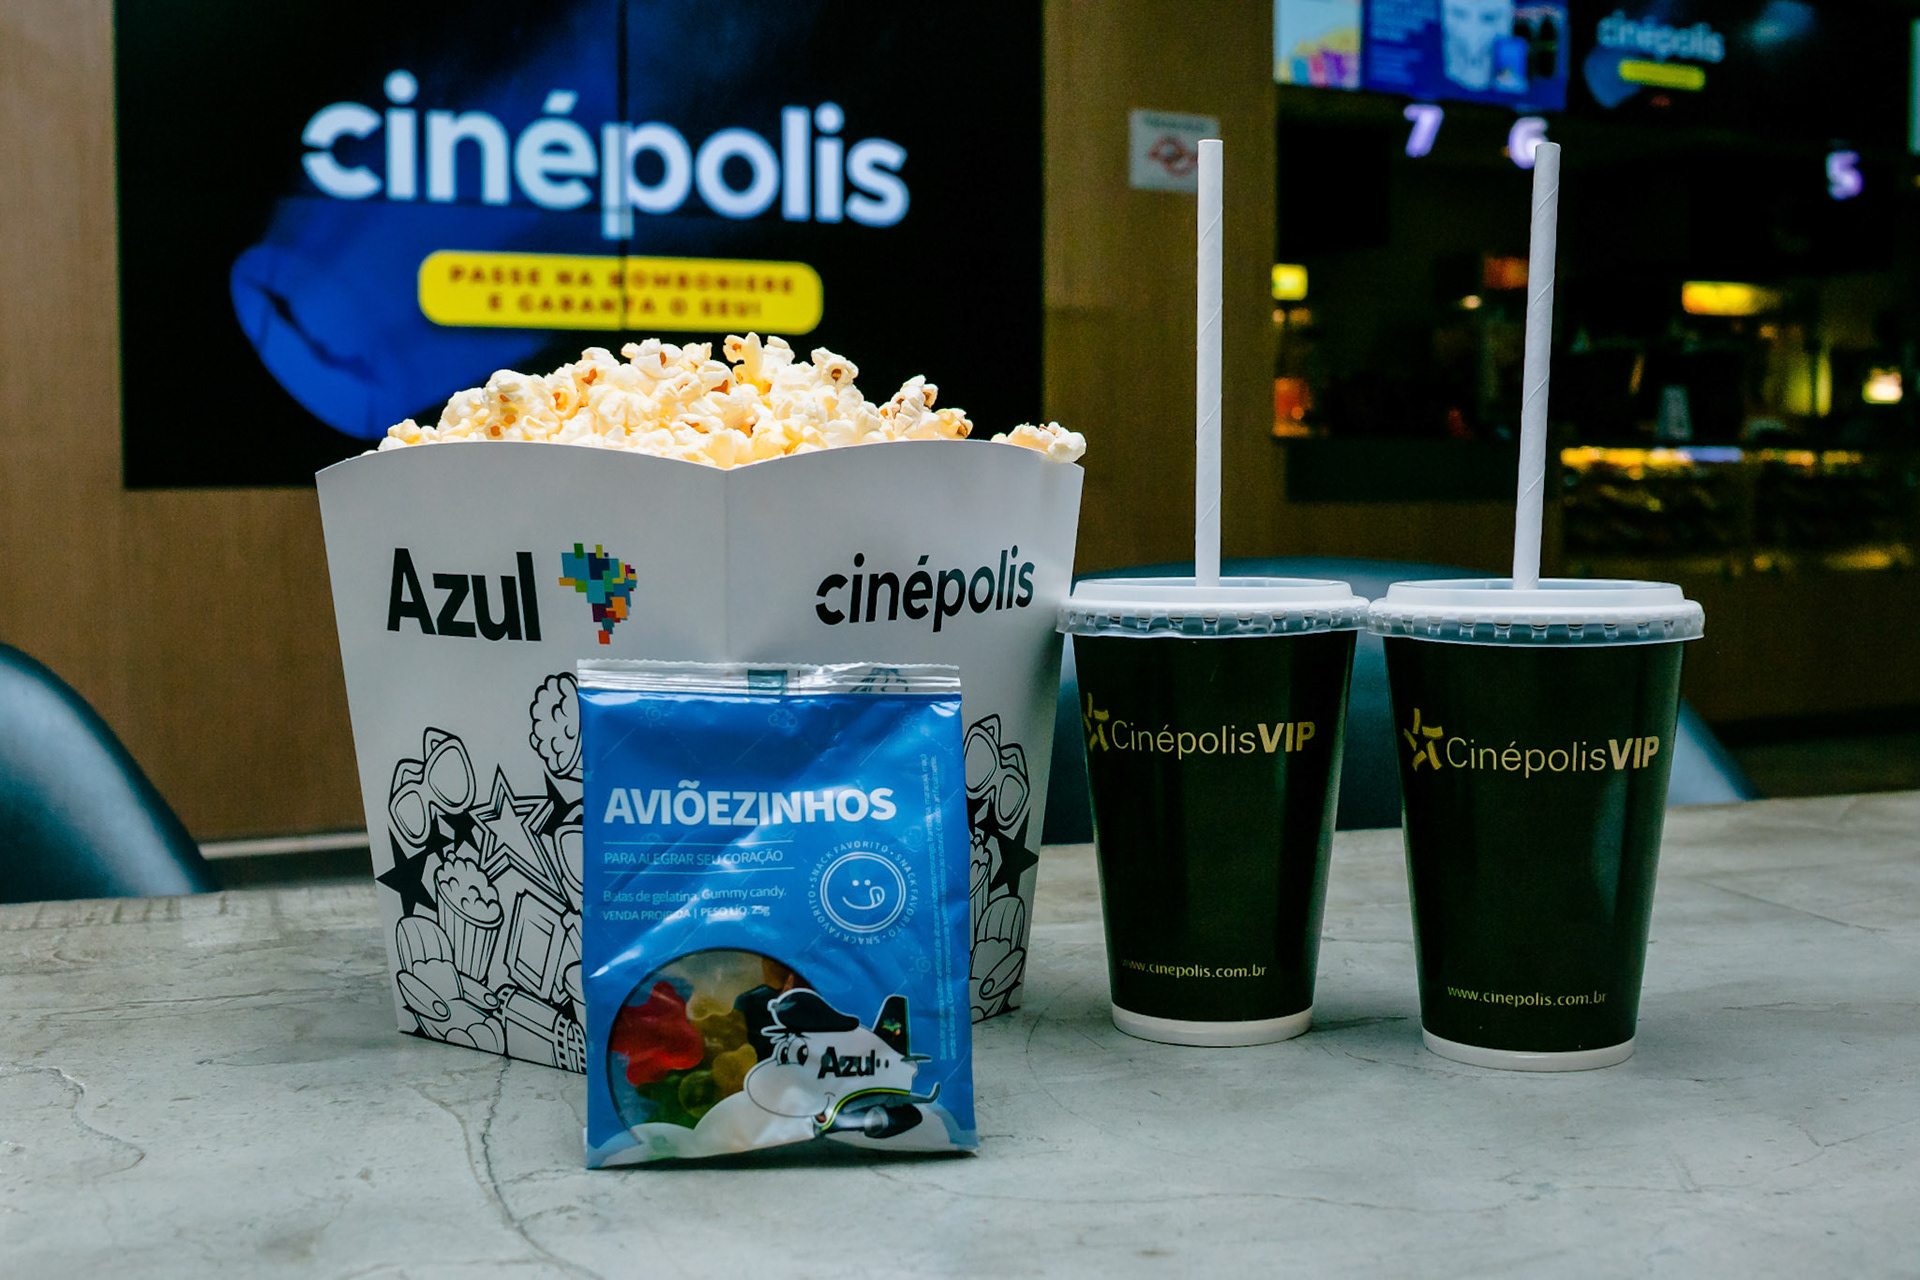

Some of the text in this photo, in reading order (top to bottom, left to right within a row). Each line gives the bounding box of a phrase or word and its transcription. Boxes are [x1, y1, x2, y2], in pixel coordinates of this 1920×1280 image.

[302, 69, 911, 240] cinépolis
[1403, 104, 1445, 157] 7
[1508, 116, 1550, 169] 6
[1825, 150, 1864, 201] 5
[387, 547, 542, 641] Azul
[815, 544, 1036, 633] cinépolis
[603, 779, 898, 826] AVIÕEZINHOS
[604, 848, 784, 866] PARA ALEGRAR SEU CORAÇÃO
[809, 840, 890, 883] SNACK FAVORITO
[602, 911, 640, 921] VENDA
[641, 909, 691, 921] PROIBDA
[751, 905, 771, 917] 25g
[635, 889, 651, 902] de
[701, 888, 748, 900] Gummy
[750, 885, 787, 899] candy.
[807, 890, 842, 939] FAVORITO
[887, 853, 919, 938] SNACK FAVORITO
[1122, 958, 1267, 979] www.cinepolis.com.br
[1447, 986, 1607, 1008] www.cinepolis.com.br
[817, 1046, 876, 1079] Azul
